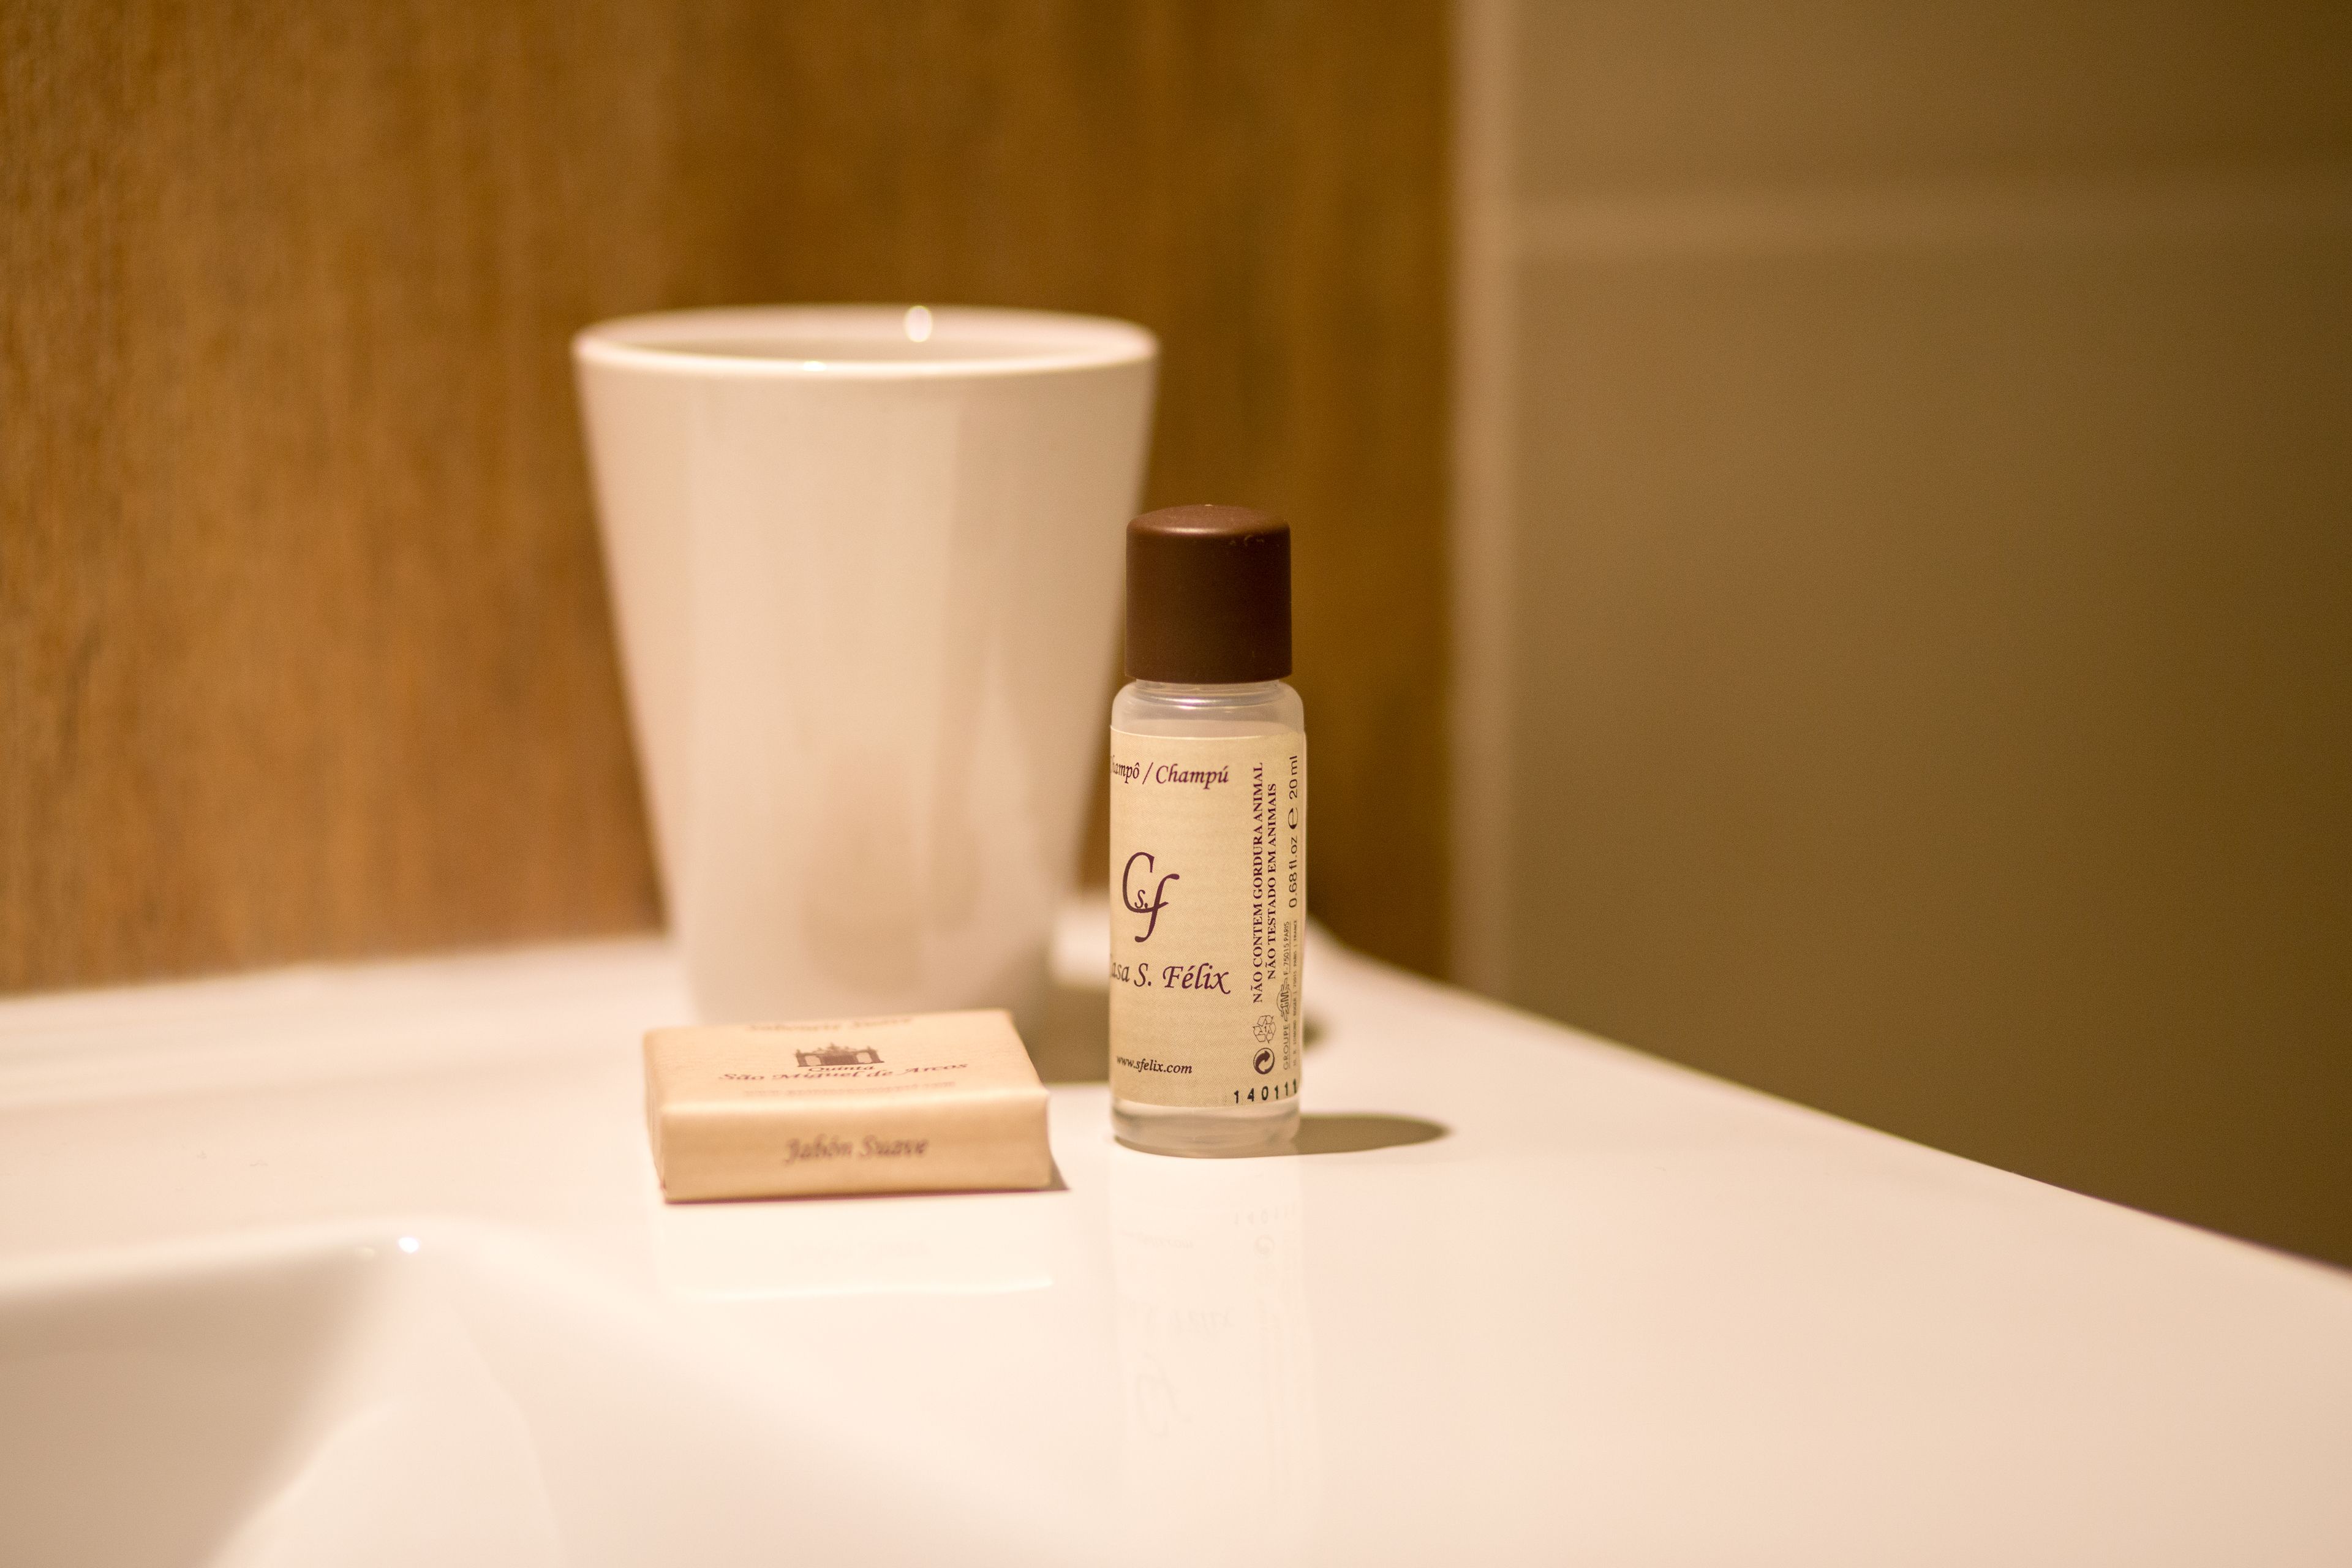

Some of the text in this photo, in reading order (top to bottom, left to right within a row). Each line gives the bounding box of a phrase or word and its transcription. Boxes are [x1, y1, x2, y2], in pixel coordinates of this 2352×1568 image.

[1111, 755, 1140, 784] ampô
[1156, 763, 1229, 790] Champú
[1289, 755, 1297, 775] ml
[1289, 778, 1297, 799] 20
[1251, 763, 1263, 1003] NÃO CONTEM GORDURA ANIMAL
[1265, 783, 1276, 979] NÃO TESTADO EM ANIMAIS
[1110, 962, 1231, 995] asa S. Félix
[772, 1071, 860, 1080] Miguel
[897, 1063, 969, 1075] Arcos
[1117, 1055, 1193, 1074] www.sfelix.com
[859, 1134, 929, 1159] Suave
